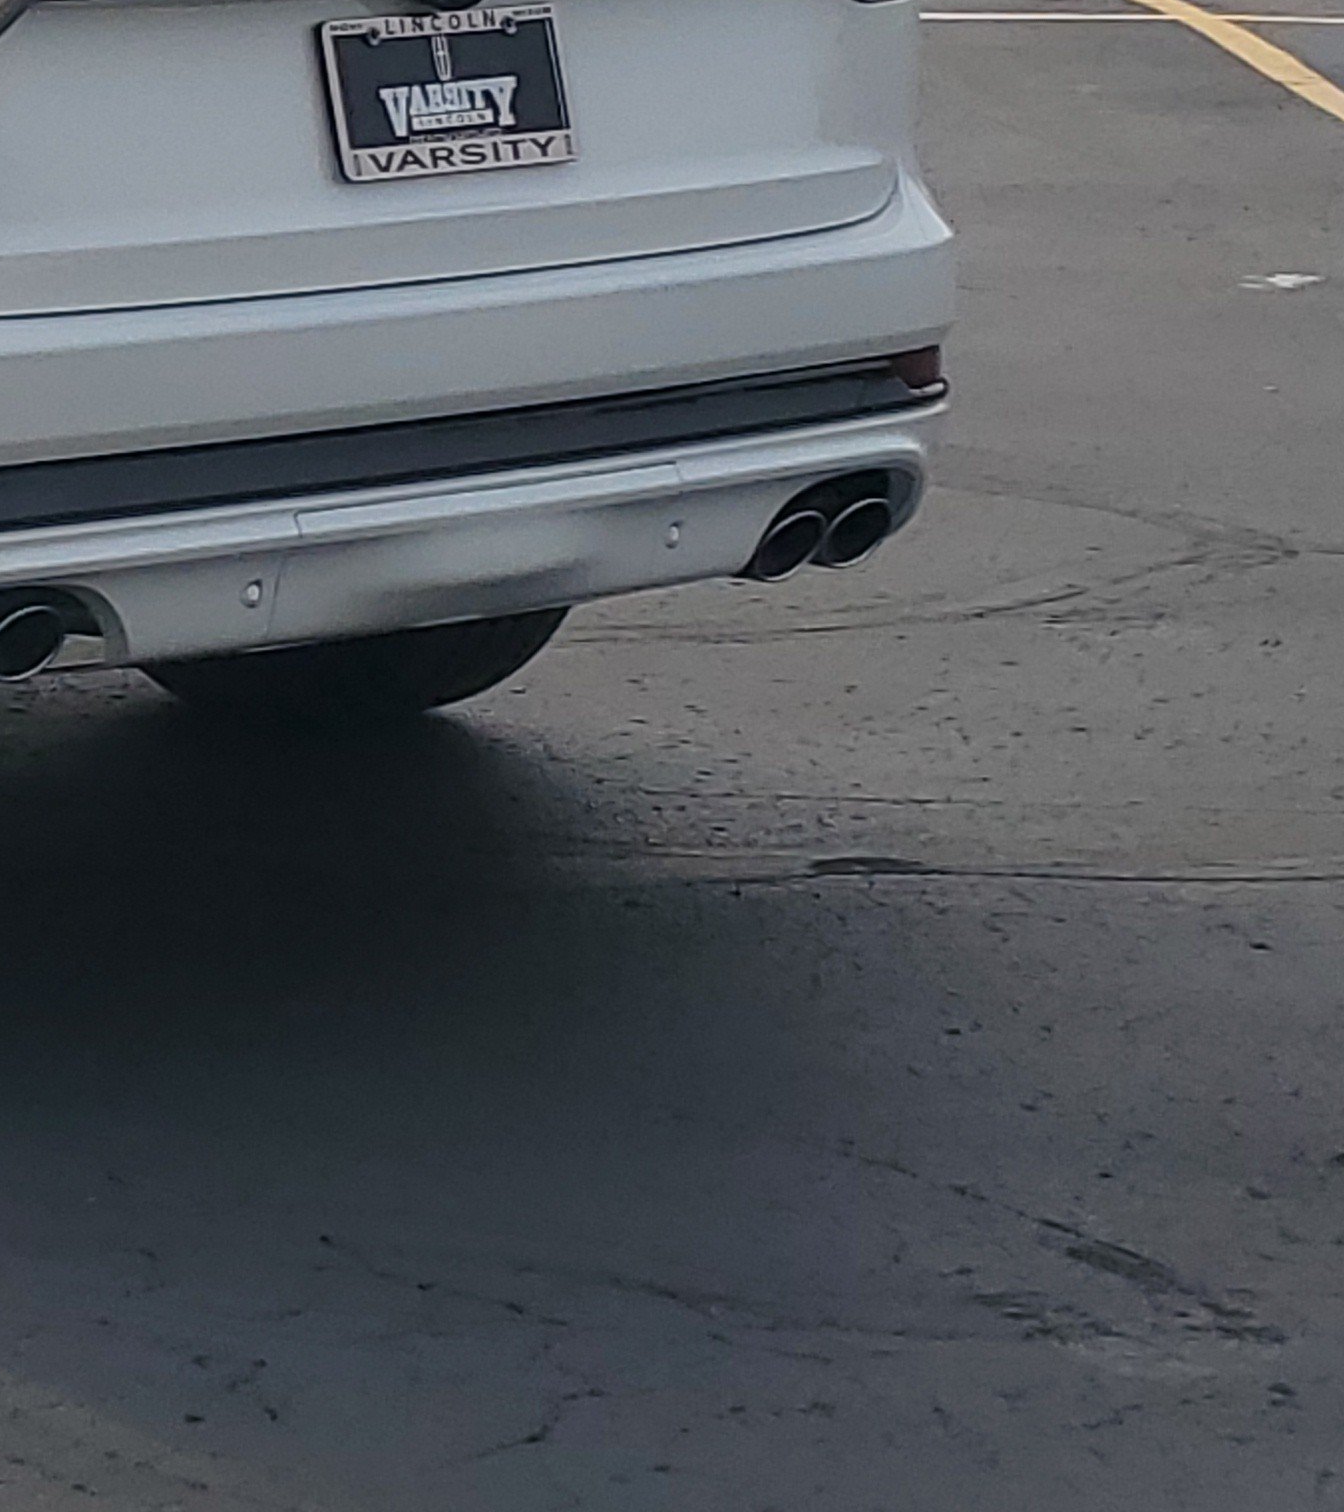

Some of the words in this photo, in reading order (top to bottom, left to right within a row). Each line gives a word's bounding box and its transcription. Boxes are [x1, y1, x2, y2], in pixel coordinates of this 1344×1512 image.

[384, 9, 497, 36] LINCOLN
[378, 75, 518, 138] VARSITY
[367, 135, 558, 173] VARSITY
